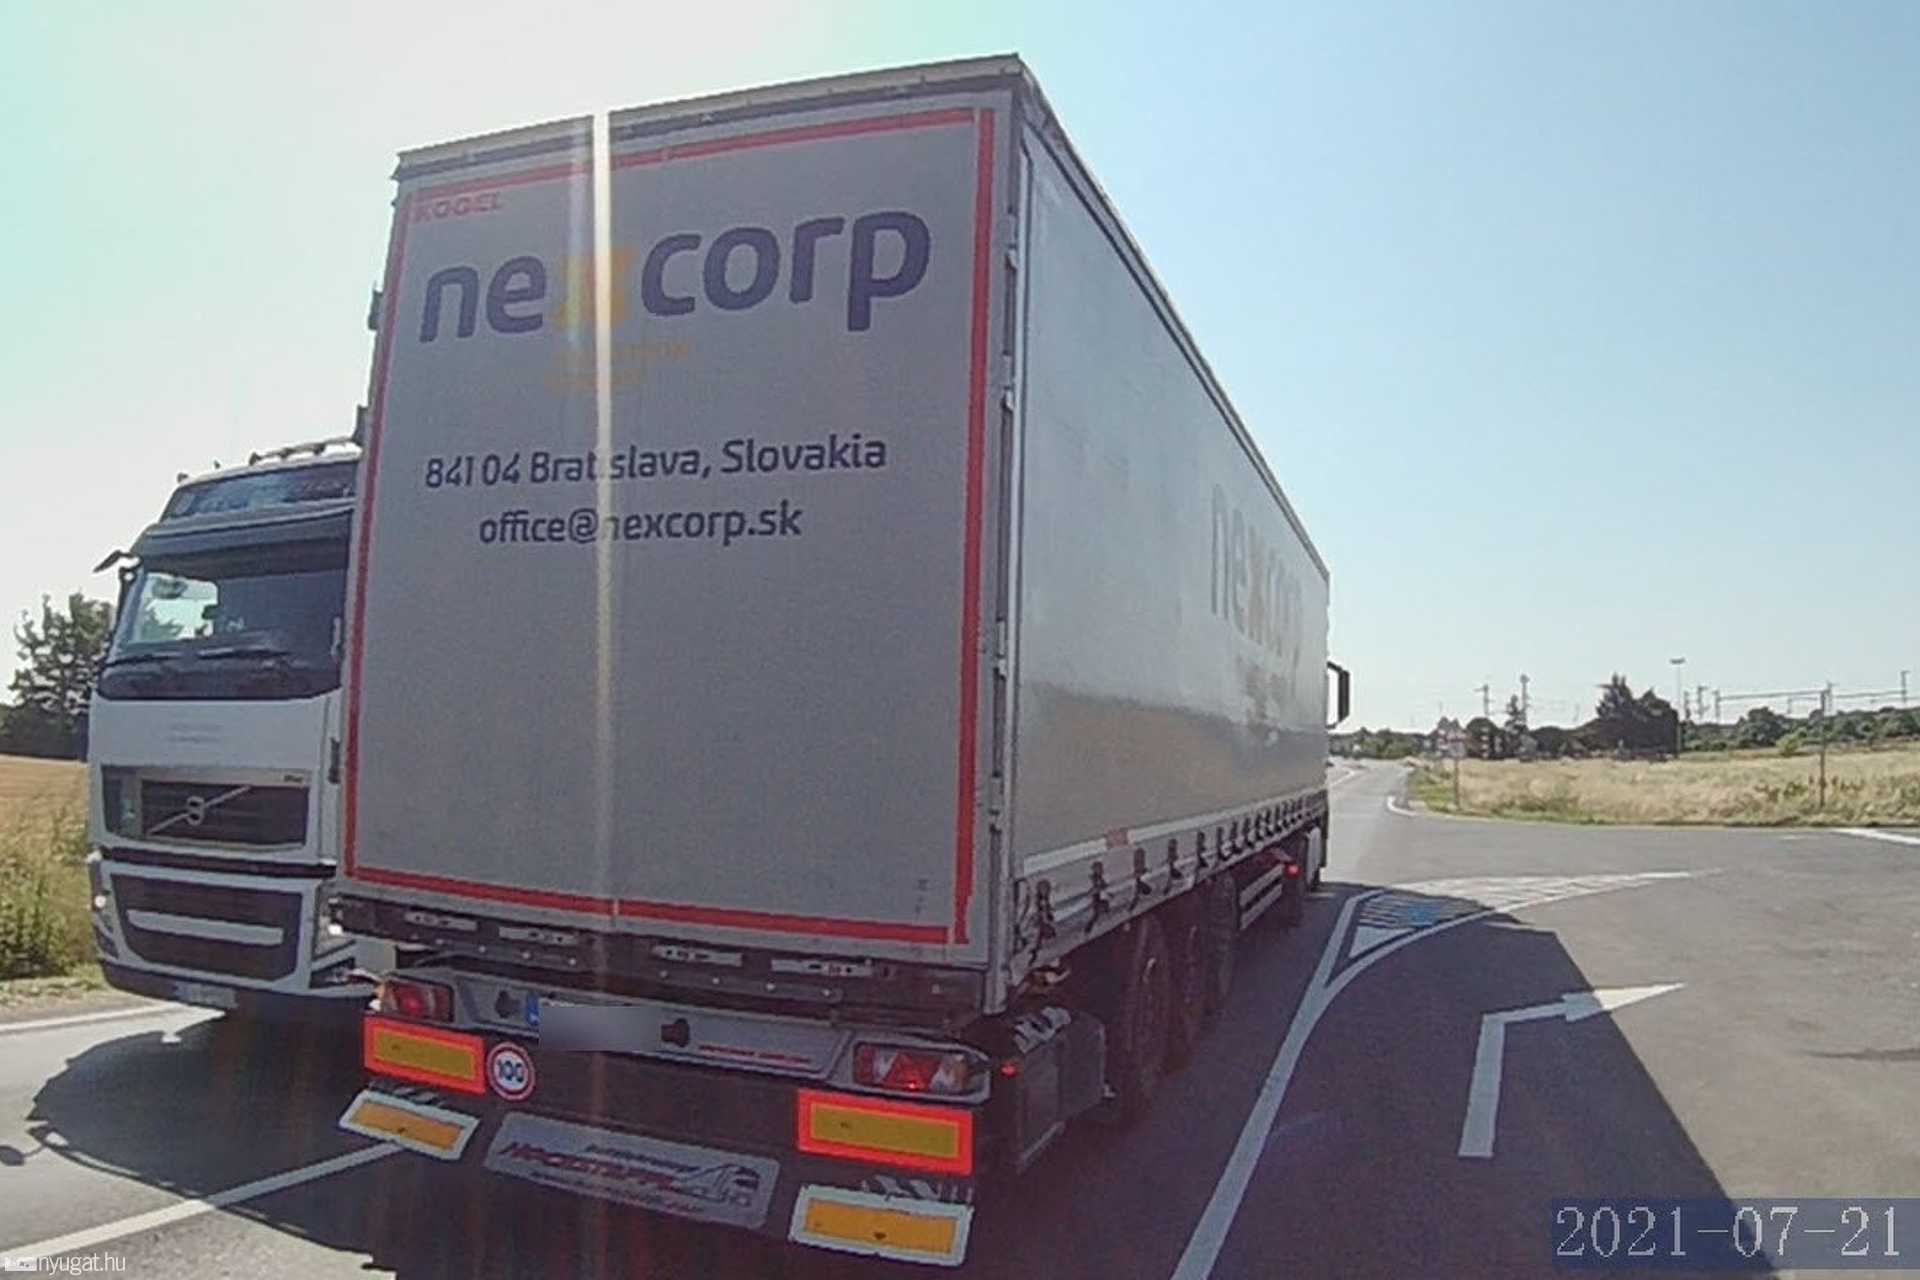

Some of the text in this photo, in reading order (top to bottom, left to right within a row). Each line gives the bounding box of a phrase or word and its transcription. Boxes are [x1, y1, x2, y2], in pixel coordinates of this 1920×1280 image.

[530, 444, 712, 484] Bratslava,
[720, 433, 887, 474] Slovakia
[479, 499, 804, 547] office@nexcorp.sk
[497, 1059, 524, 1084] 100
